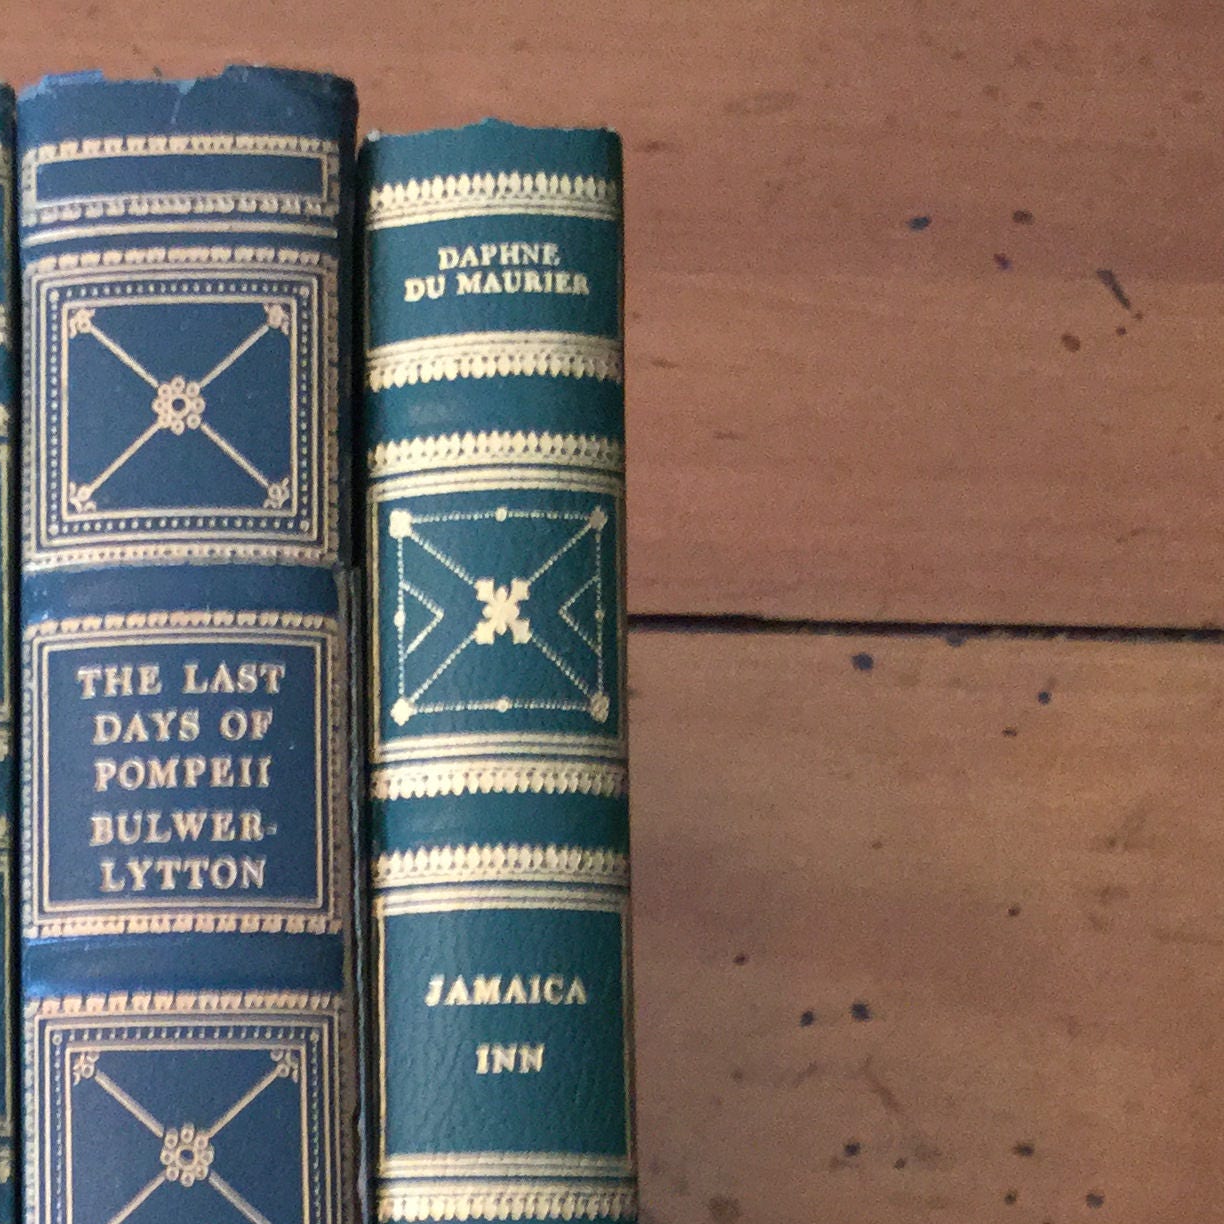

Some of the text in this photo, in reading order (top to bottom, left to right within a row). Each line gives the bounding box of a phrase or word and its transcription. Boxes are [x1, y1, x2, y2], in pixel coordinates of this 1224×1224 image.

[438, 242, 561, 270] DAPHNE
[404, 270, 590, 302] DU MAURIER
[77, 660, 285, 700] THE LAST
[93, 707, 273, 745] DAYS OF
[93, 754, 272, 792] POMPEII
[99, 855, 267, 893] LYTTON
[424, 973, 588, 1007] JAMAICA
[475, 1042, 545, 1075] INN
